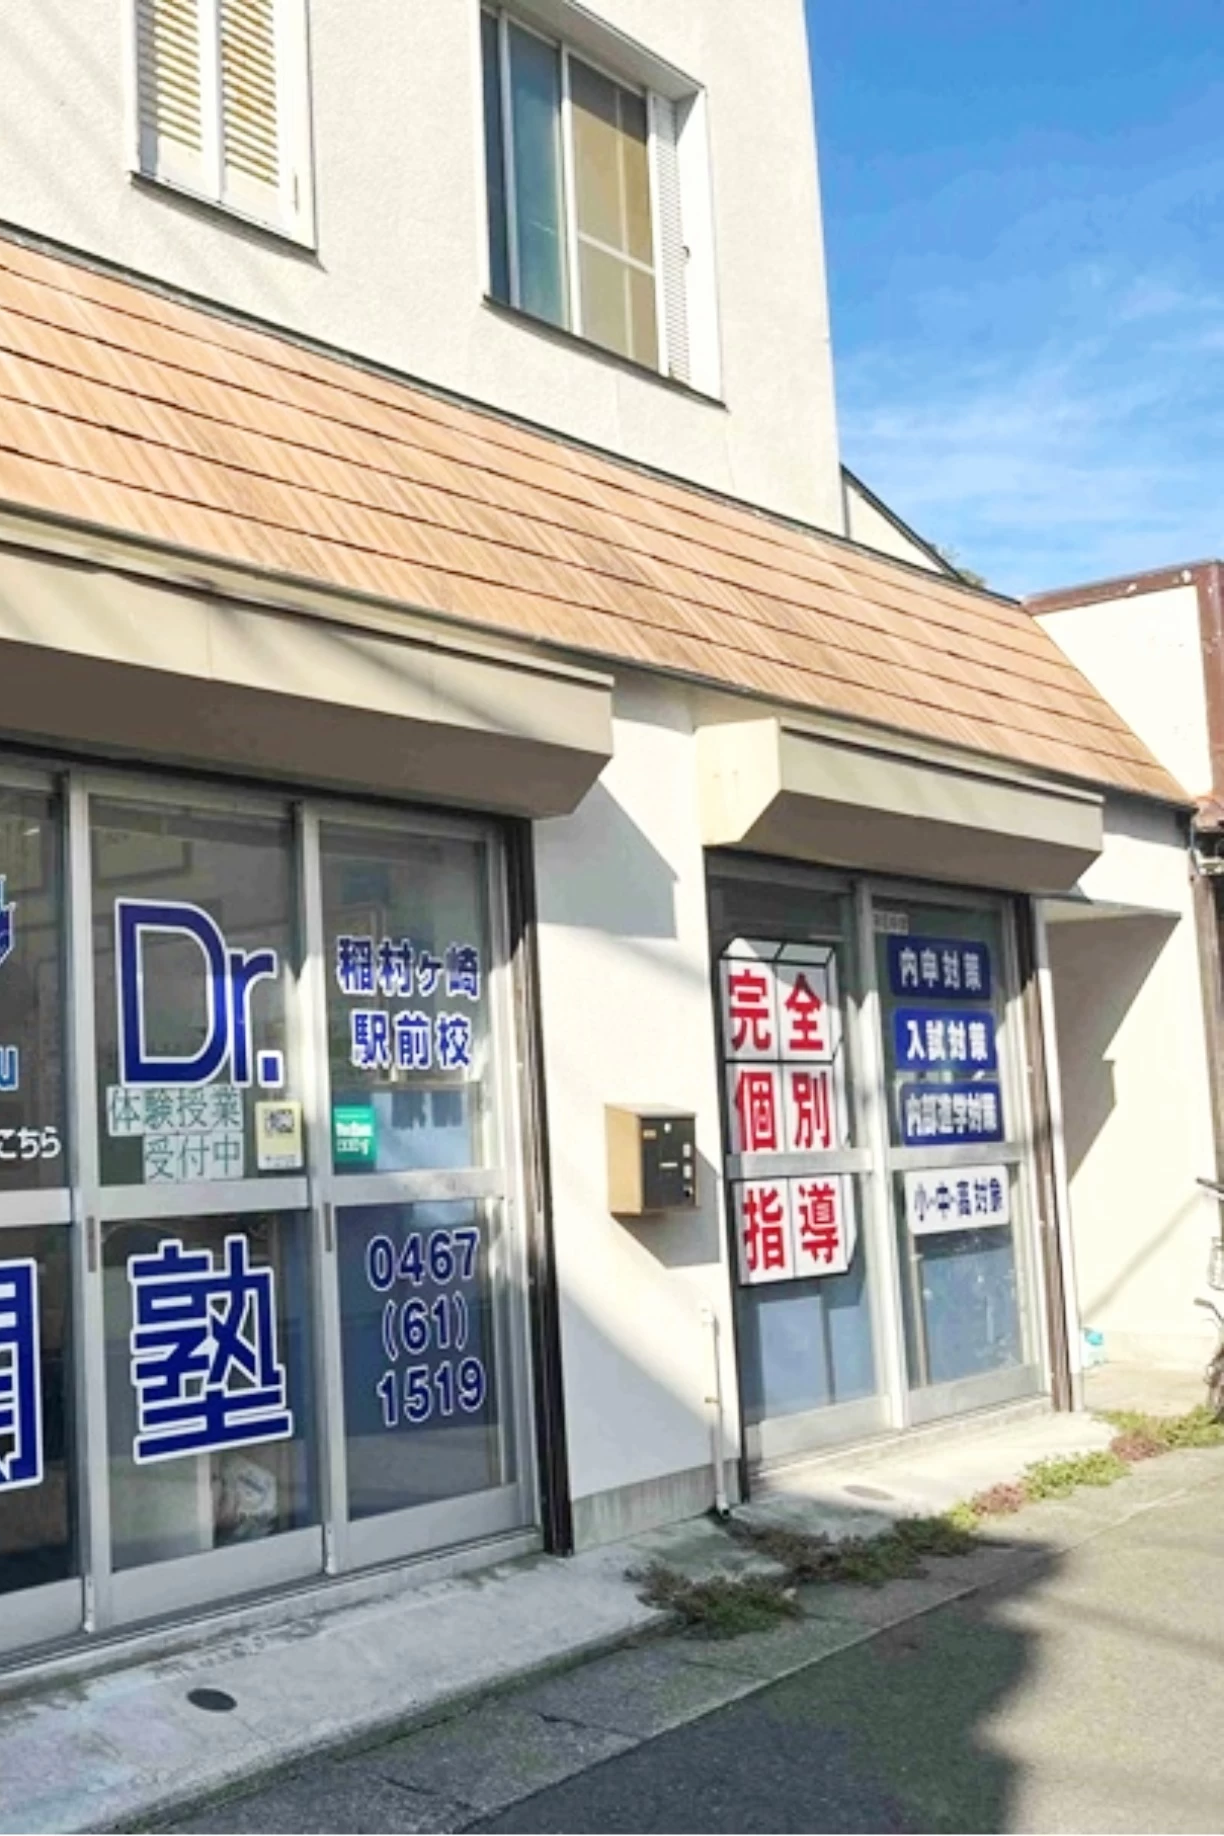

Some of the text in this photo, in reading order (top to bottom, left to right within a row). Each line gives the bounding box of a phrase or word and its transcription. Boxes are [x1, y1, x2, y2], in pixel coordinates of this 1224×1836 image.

[115, 897, 283, 1087] Dr.
[729, 969, 825, 1051] 完全
[351, 1008, 472, 1070] 駅前校
[906, 1019, 989, 1061] 入試対策
[111, 1086, 240, 1131] 体験授業
[735, 1071, 831, 1151] 個別
[147, 1136, 241, 1180] 受付中
[366, 1227, 480, 1292] 0467
[743, 1182, 839, 1270] 指導
[382, 1290, 468, 1361] (61)
[377, 1357, 486, 1427] 1519
